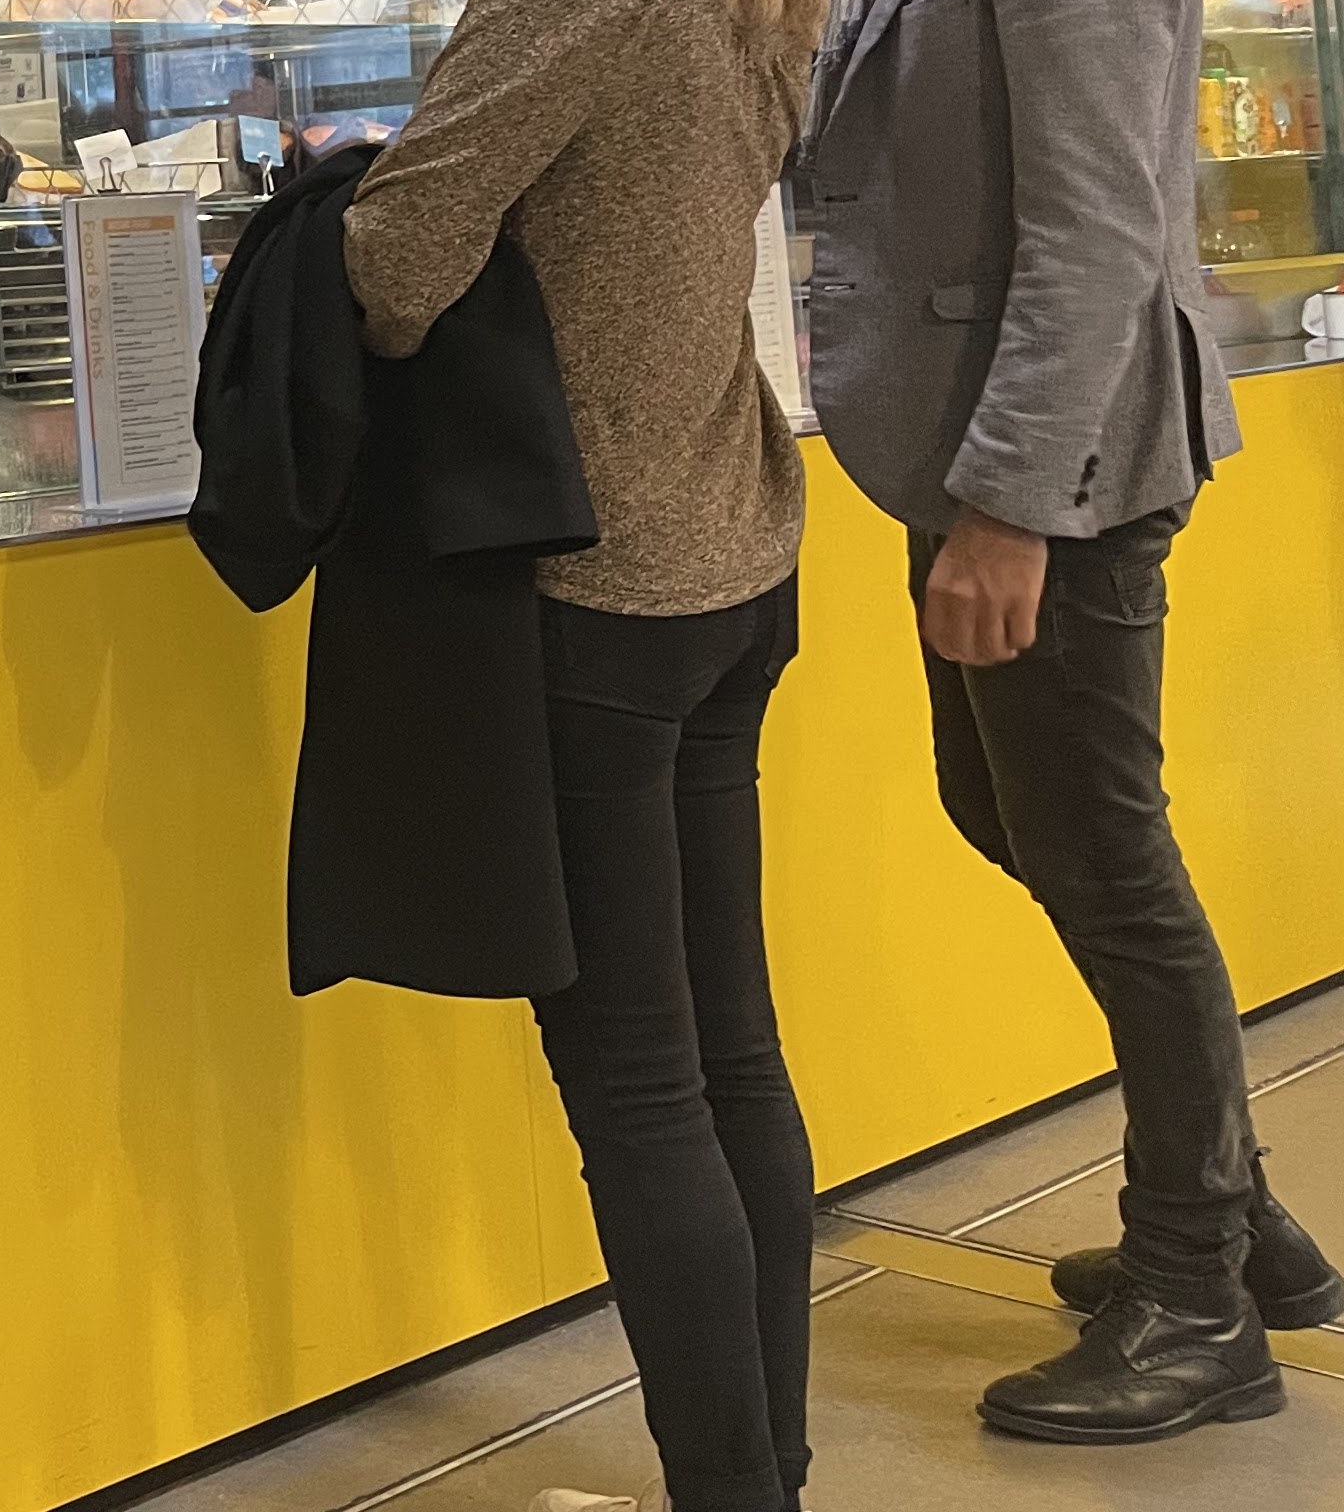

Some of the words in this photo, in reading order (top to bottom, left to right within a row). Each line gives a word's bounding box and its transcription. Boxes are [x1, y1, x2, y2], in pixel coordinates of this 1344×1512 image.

[82, 220, 100, 277] Food
[87, 284, 101, 300] &
[88, 306, 105, 380] Drinks
